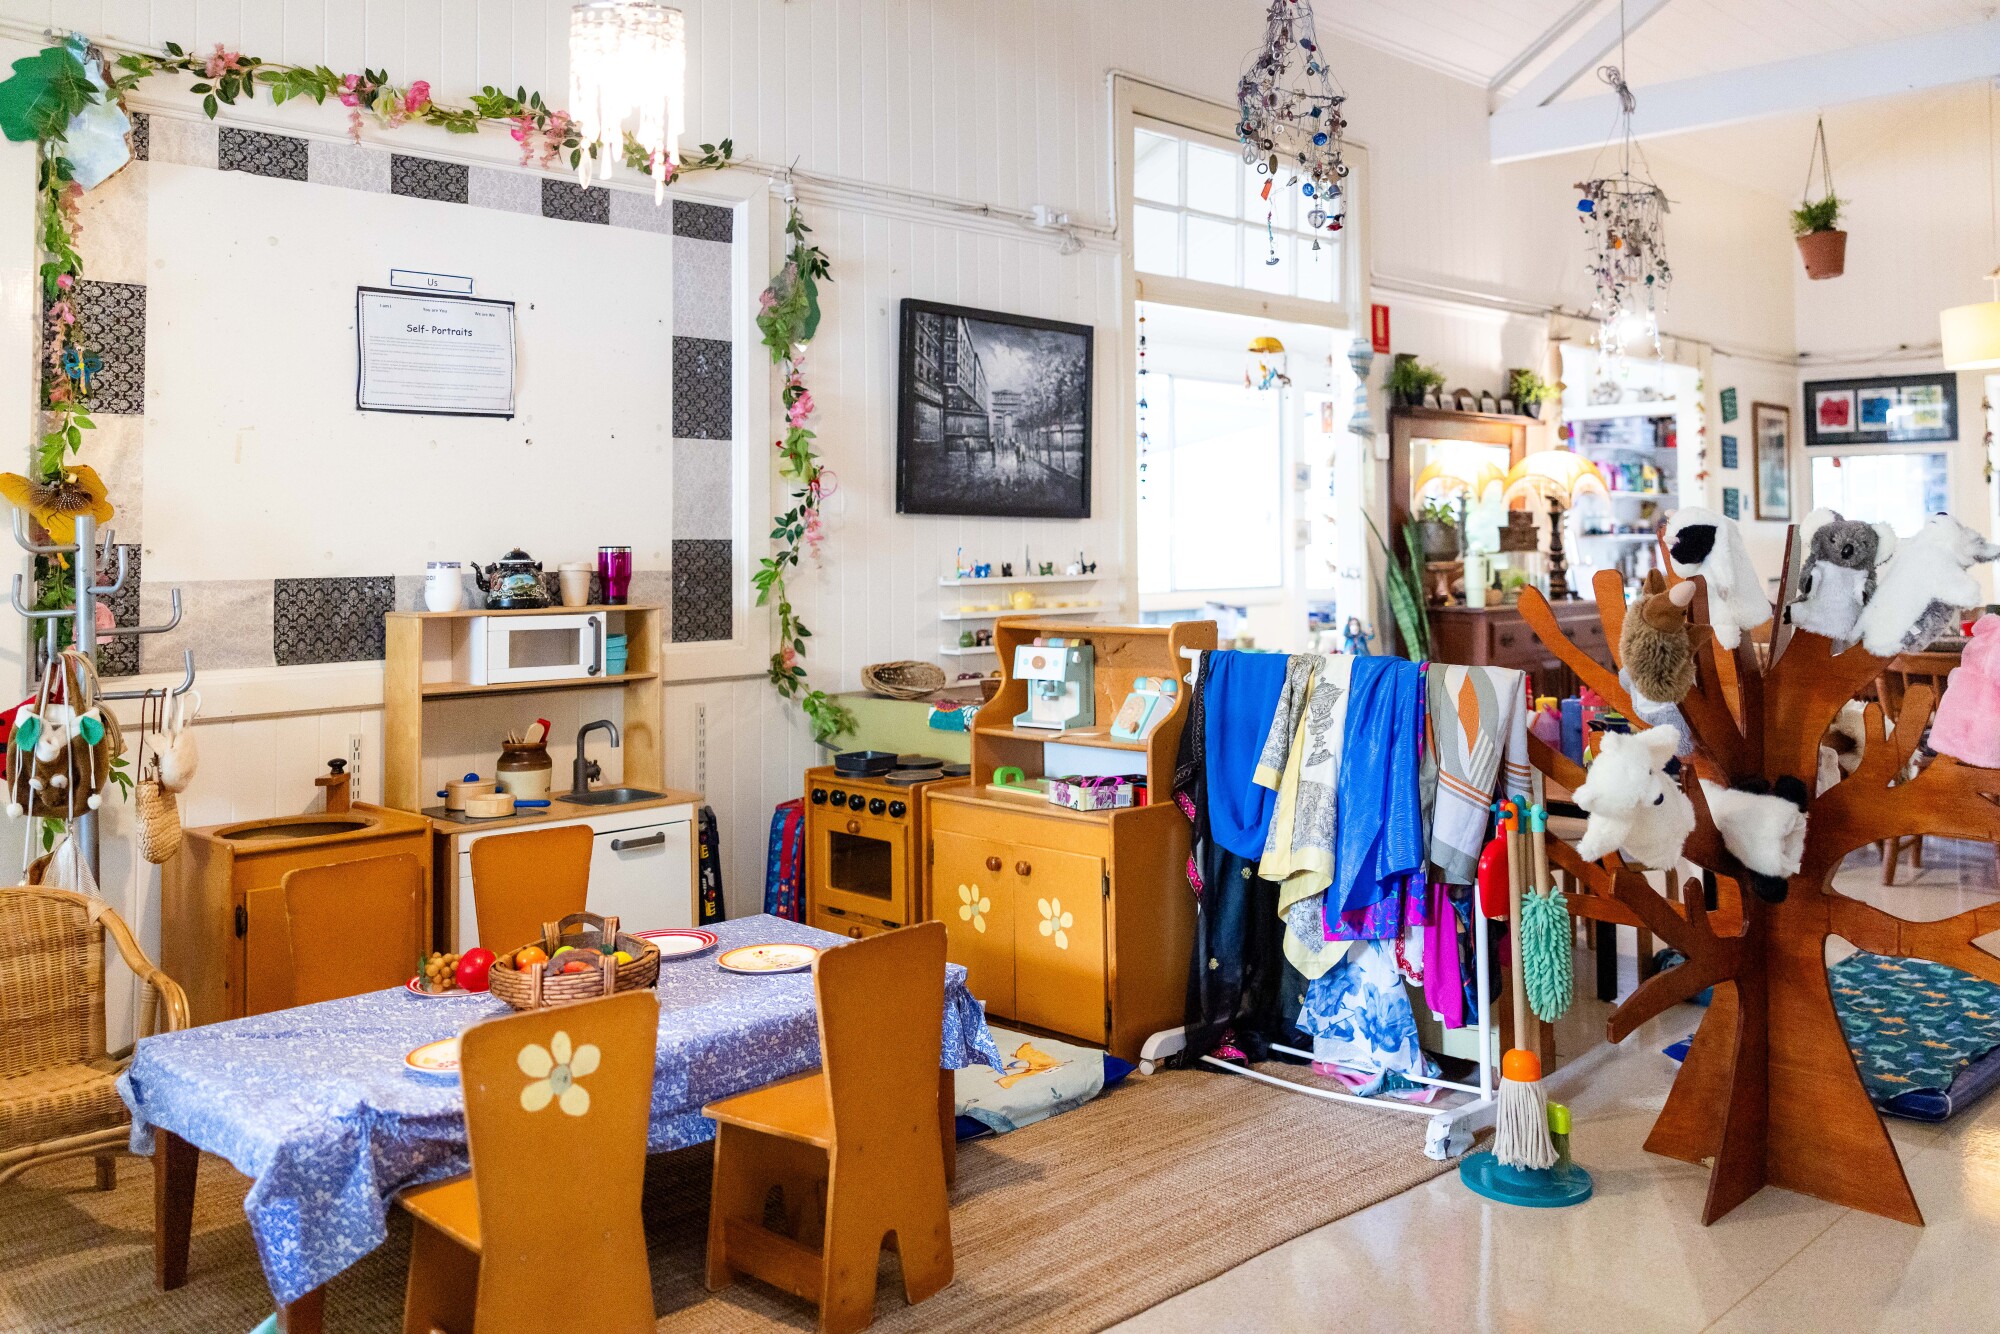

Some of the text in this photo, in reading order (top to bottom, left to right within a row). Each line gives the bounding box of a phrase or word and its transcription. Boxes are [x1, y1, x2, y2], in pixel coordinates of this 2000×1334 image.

[427, 278, 438, 286] Us
[406, 324, 473, 336] Self- Portraits
